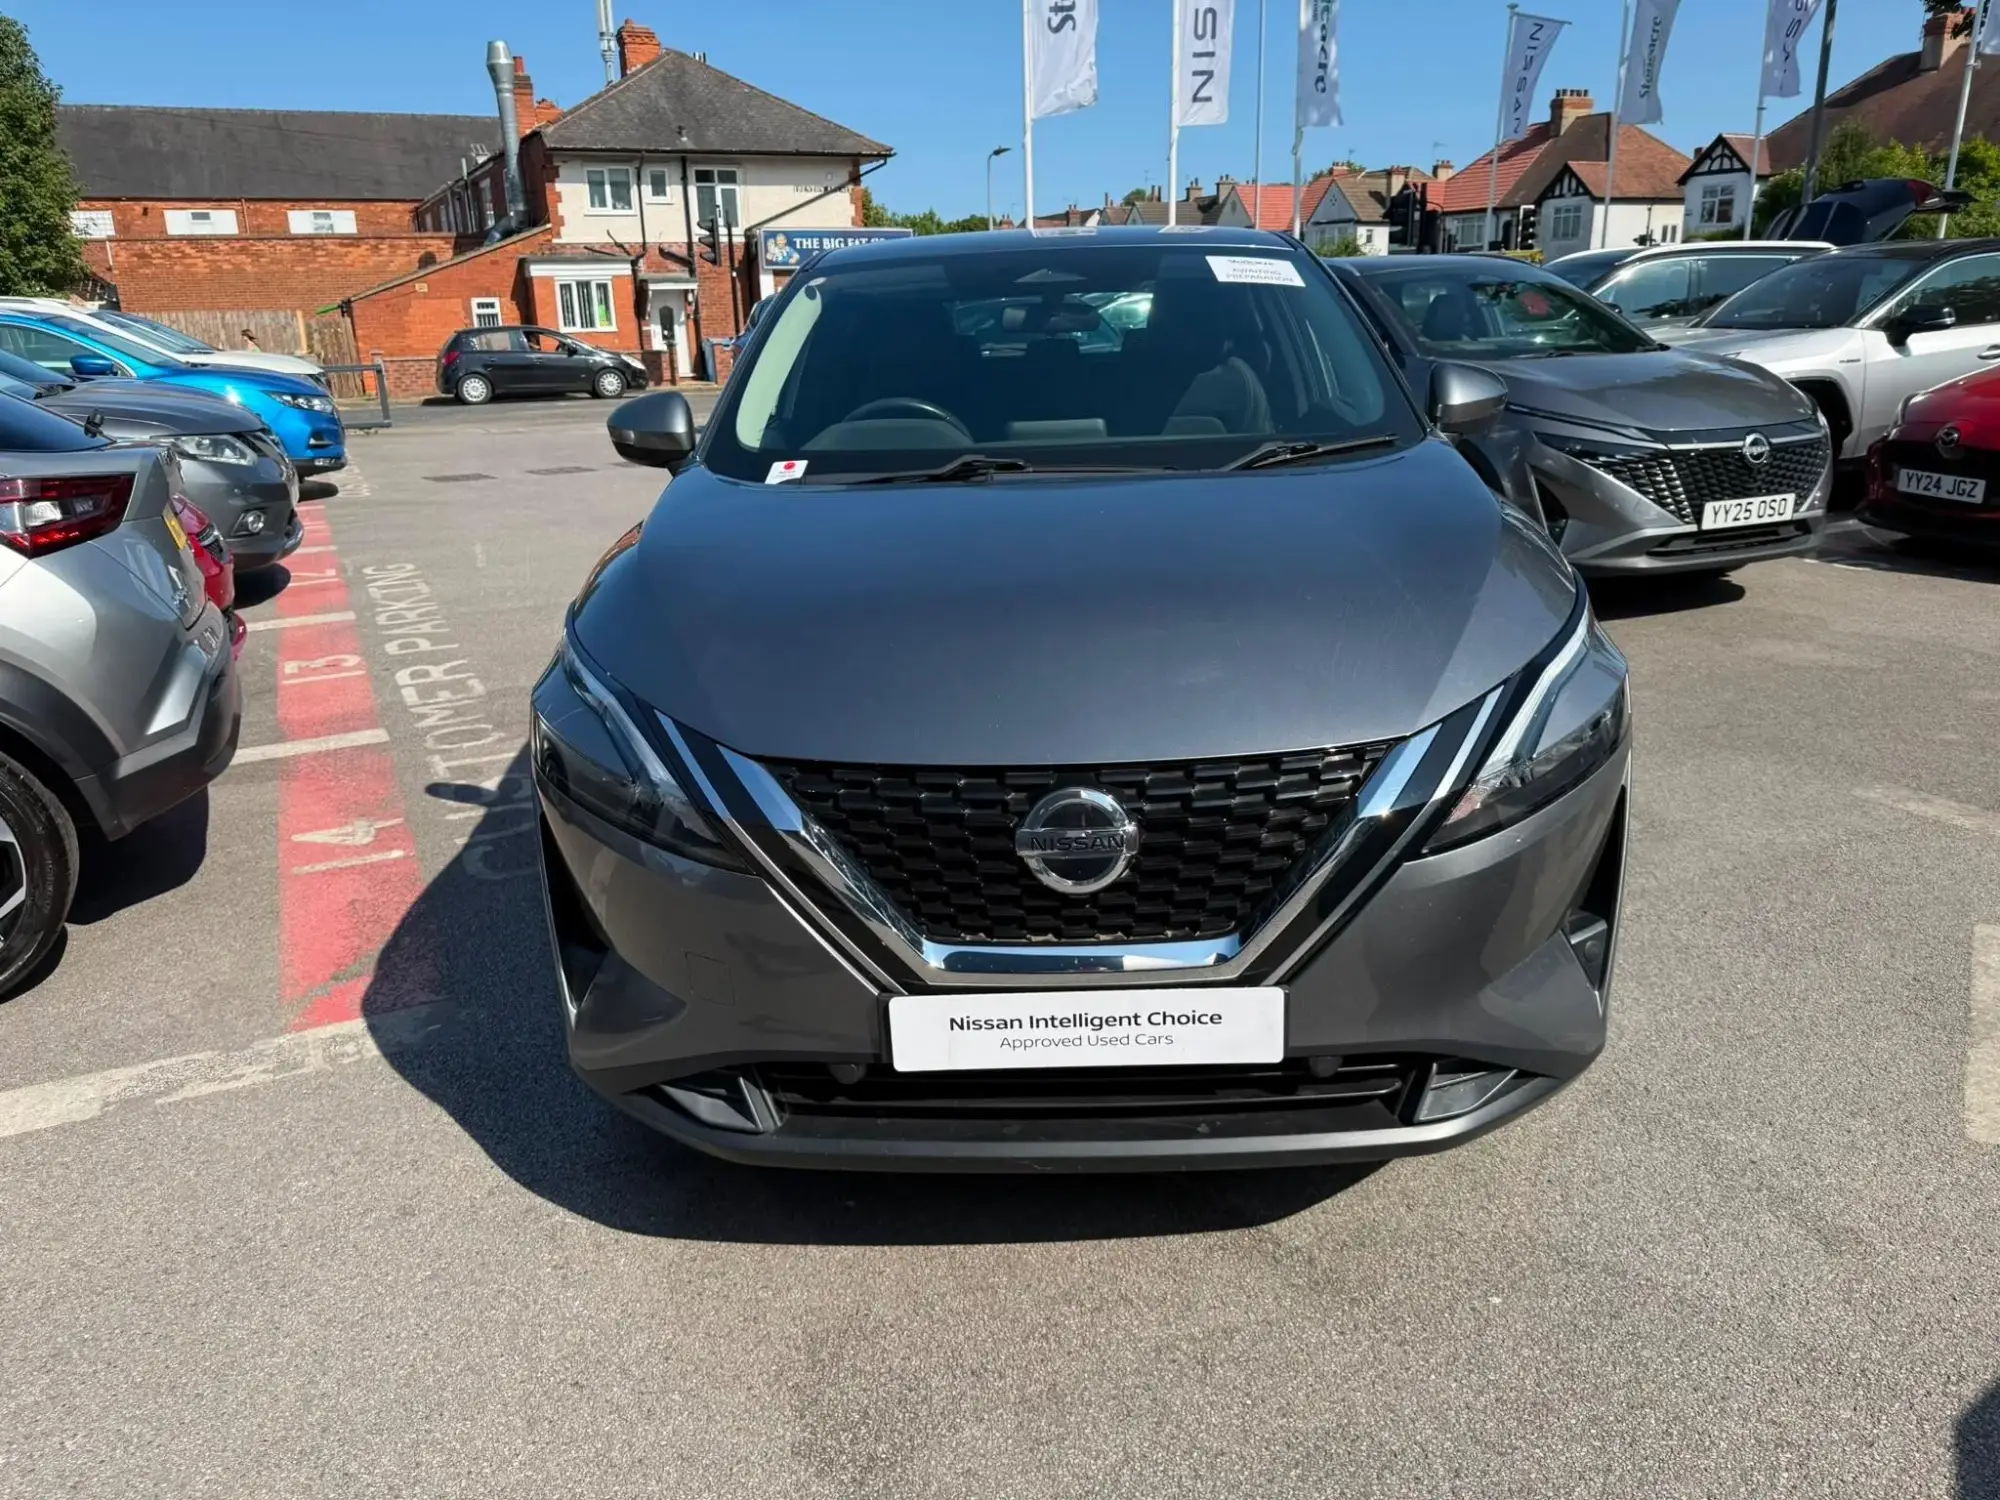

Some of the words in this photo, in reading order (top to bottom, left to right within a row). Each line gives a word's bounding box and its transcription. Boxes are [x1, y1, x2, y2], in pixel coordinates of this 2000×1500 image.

[1047, 0, 1076, 34] St
[1314, 0, 1331, 93] eacre
[1513, 22, 1544, 134] NISSAN
[793, 238, 820, 249] THE
[823, 238, 845, 249] BIG
[848, 238, 870, 247] FAT
[1906, 471, 1942, 493] YY24
[1946, 478, 1979, 499] JGZ
[1712, 501, 1754, 524] YY25
[362, 562, 460, 656] PARKING
[1030, 836, 1125, 851] NISSAN
[948, 1015, 1023, 1032] Nissan
[1028, 1011, 1142, 1031] Intelligent
[1146, 1009, 1223, 1027] Choice
[999, 1034, 1083, 1051] Approved
[1087, 1033, 1130, 1047] Used
[1134, 1032, 1174, 1046] Cars
